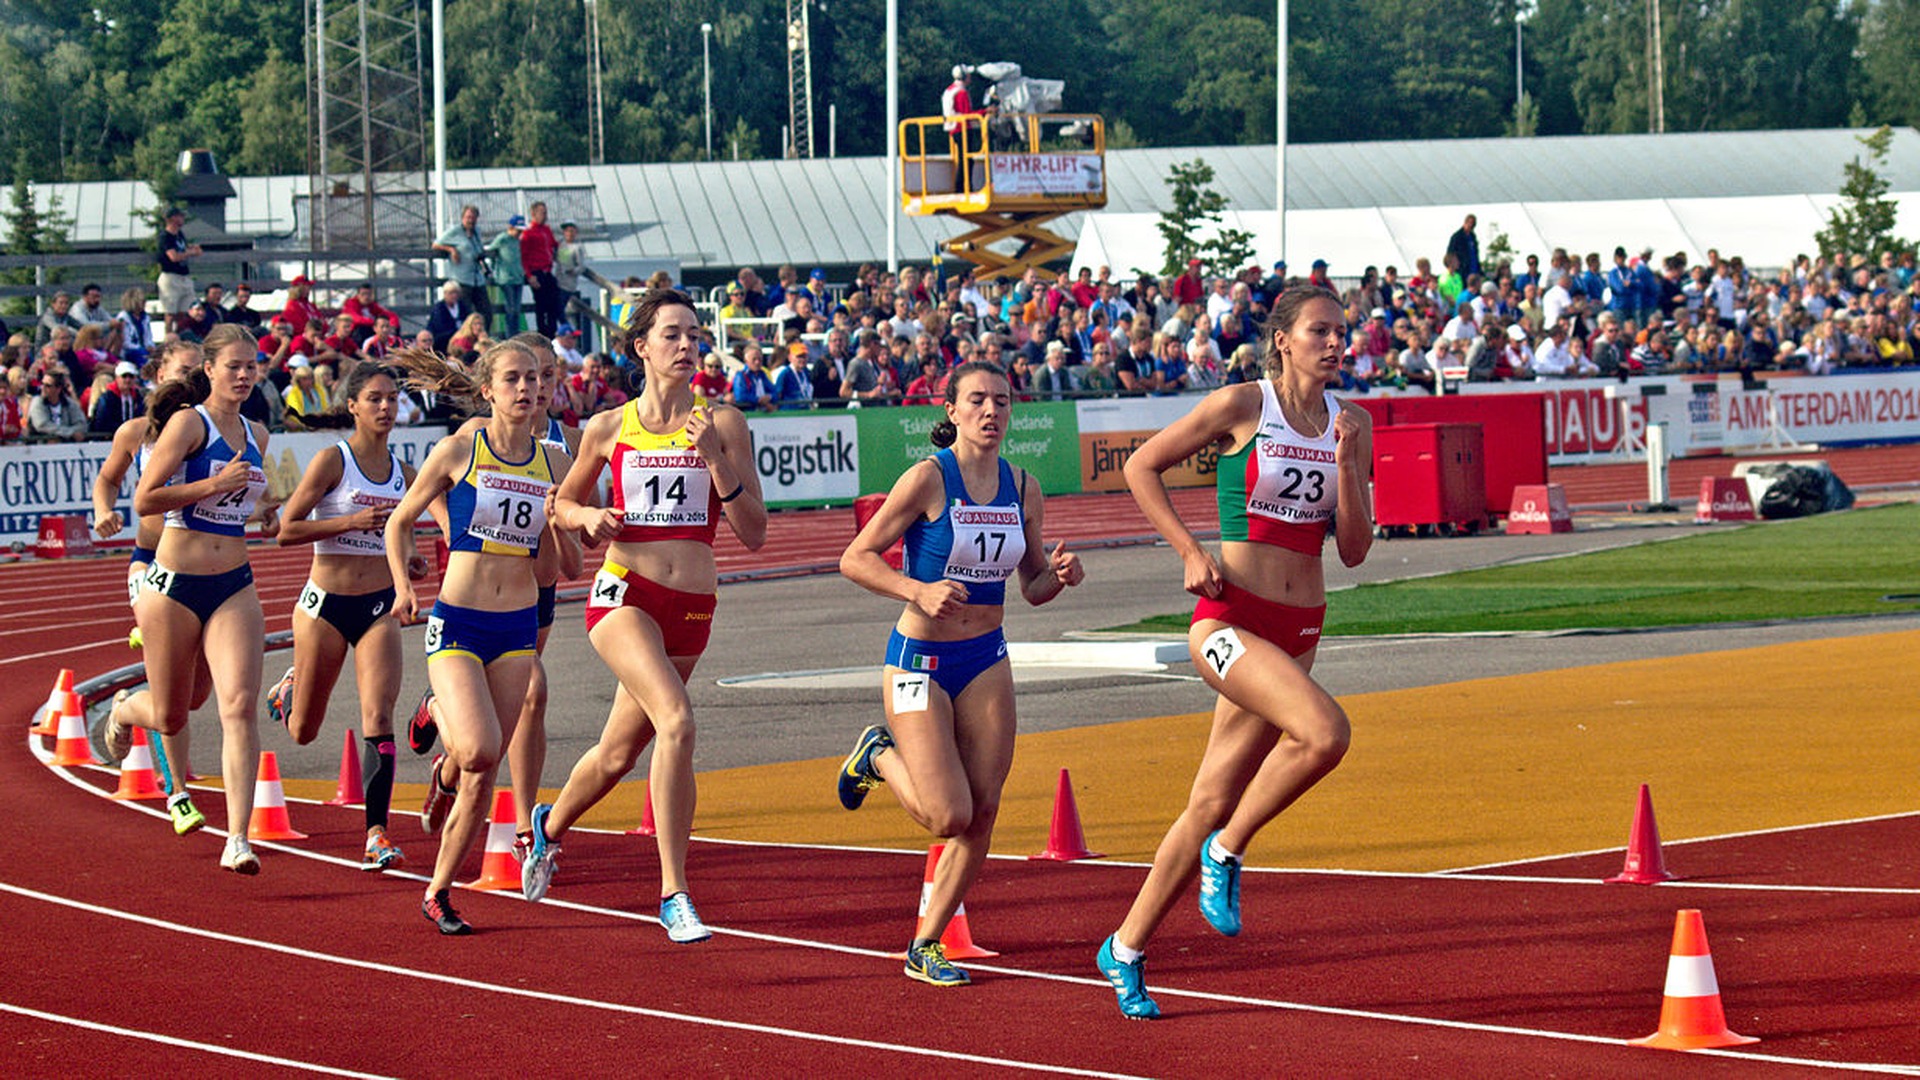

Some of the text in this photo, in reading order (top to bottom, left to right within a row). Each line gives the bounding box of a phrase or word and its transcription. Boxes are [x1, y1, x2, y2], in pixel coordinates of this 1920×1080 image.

[1010, 156, 1077, 173] HYR-LIFT
[644, 475, 688, 505] 14
[1278, 466, 1325, 503] 23
[498, 497, 532, 529] 18
[626, 512, 682, 522] ESKILSTUNA
[965, 511, 1018, 525] BAUHAUS
[1250, 500, 1313, 519] ESKILSTUNA
[1510, 511, 1549, 522] OMEGA
[471, 524, 525, 544] ESKILSTUNA
[974, 531, 1006, 562] 17
[146, 561, 169, 593] 24
[947, 565, 999, 579] ESKILSTUNA
[1206, 636, 1234, 673] 23
